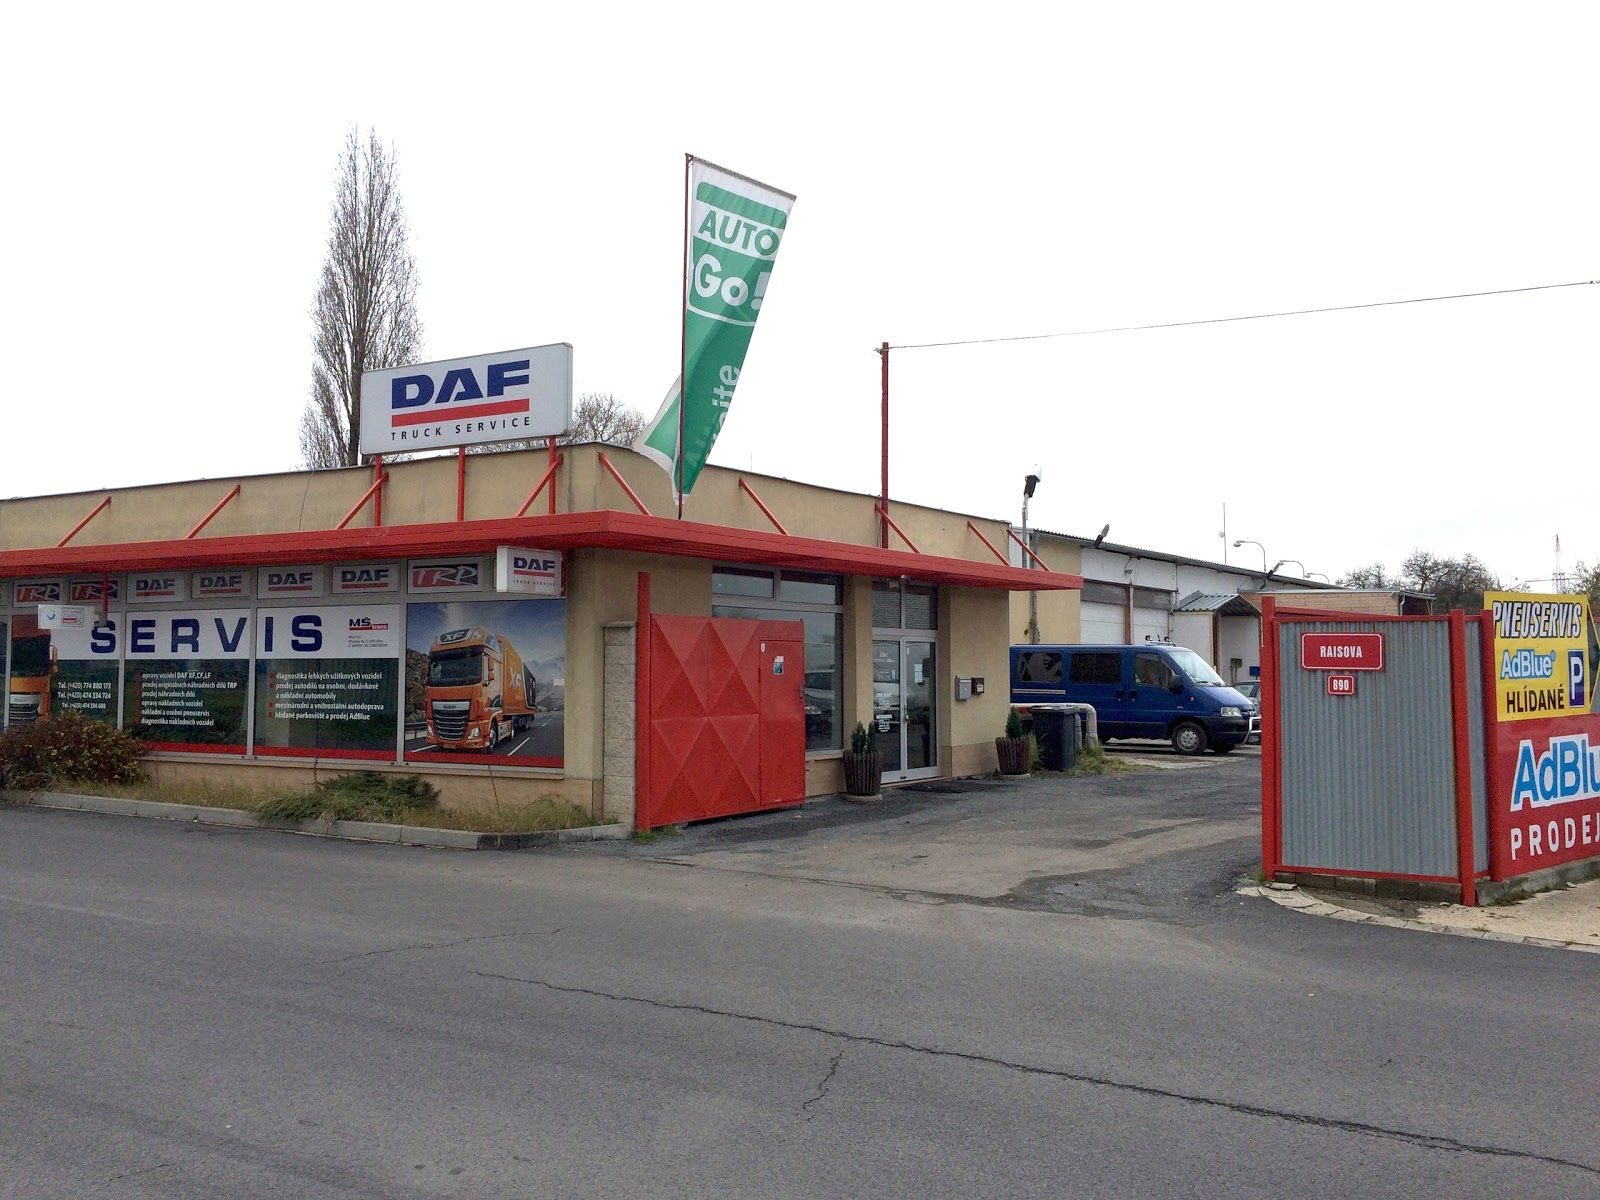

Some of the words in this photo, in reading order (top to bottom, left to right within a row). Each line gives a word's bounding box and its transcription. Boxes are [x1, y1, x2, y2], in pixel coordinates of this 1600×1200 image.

[698, 209, 780, 256] AUTO
[694, 253, 771, 310] Go!
[391, 359, 530, 410] DAF
[391, 427, 442, 441] TRUCK
[455, 416, 530, 434] SERVICE
[513, 556, 555, 572] DAF
[200, 575, 242, 588] DAF
[268, 572, 313, 586] DAF
[341, 568, 389, 583] DAF
[413, 565, 479, 587] TRP
[136, 578, 175, 591] DAF
[17, 584, 60, 602] TRP
[349, 616, 371, 627] MŠ
[1493, 601, 1582, 639] PNEUSERVIS
[90, 614, 323, 654] SERVIS
[1320, 645, 1363, 658] RAISOVA
[275, 672, 307, 680] diagnostika
[1570, 656, 1583, 700] P
[275, 683, 293, 691] prodej
[1332, 679, 1349, 691] 890
[1506, 684, 1565, 714] HLÍDANÉ
[347, 703, 384, 711] autodoprava
[330, 713, 349, 721] prodej
